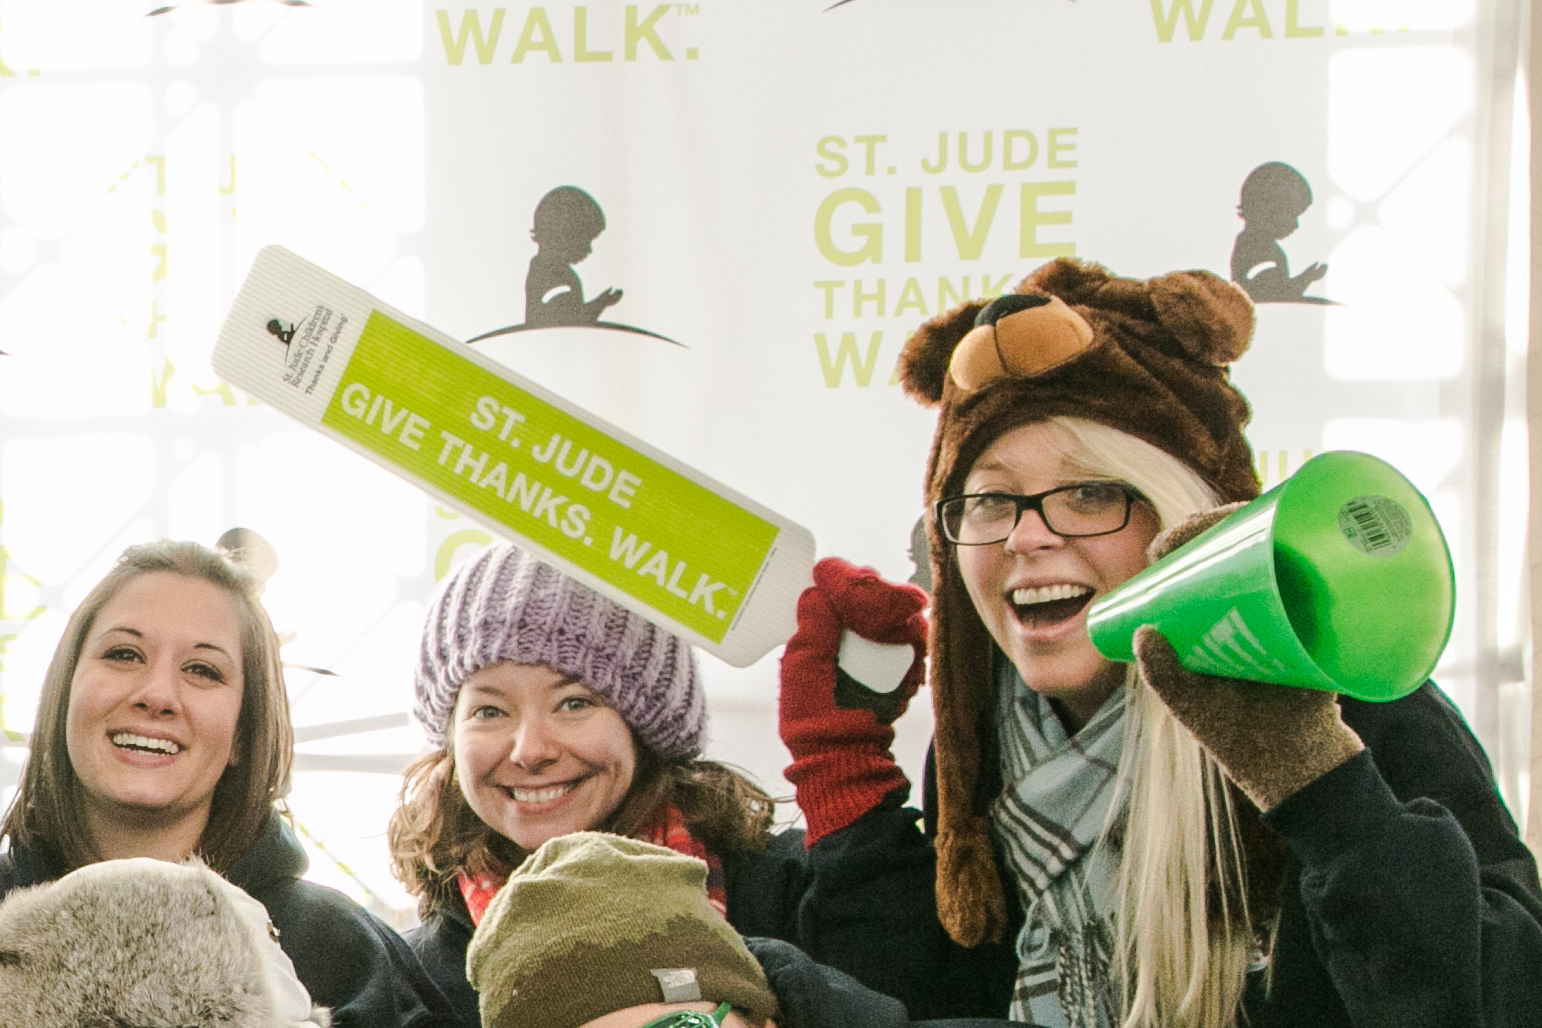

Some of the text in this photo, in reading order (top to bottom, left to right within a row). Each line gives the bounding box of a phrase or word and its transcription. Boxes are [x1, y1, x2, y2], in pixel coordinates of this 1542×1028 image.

[814, 126, 1079, 179] ST. JUDE
[813, 180, 1077, 268] GIVE
[288, 349, 304, 373] Jude
[290, 307, 334, 388] Research Hospital
[304, 313, 349, 396] Thanks and Giving
[340, 382, 432, 452] GIVE
[437, 429, 594, 547] THANKS.
[469, 395, 643, 510] ST. JUDE
